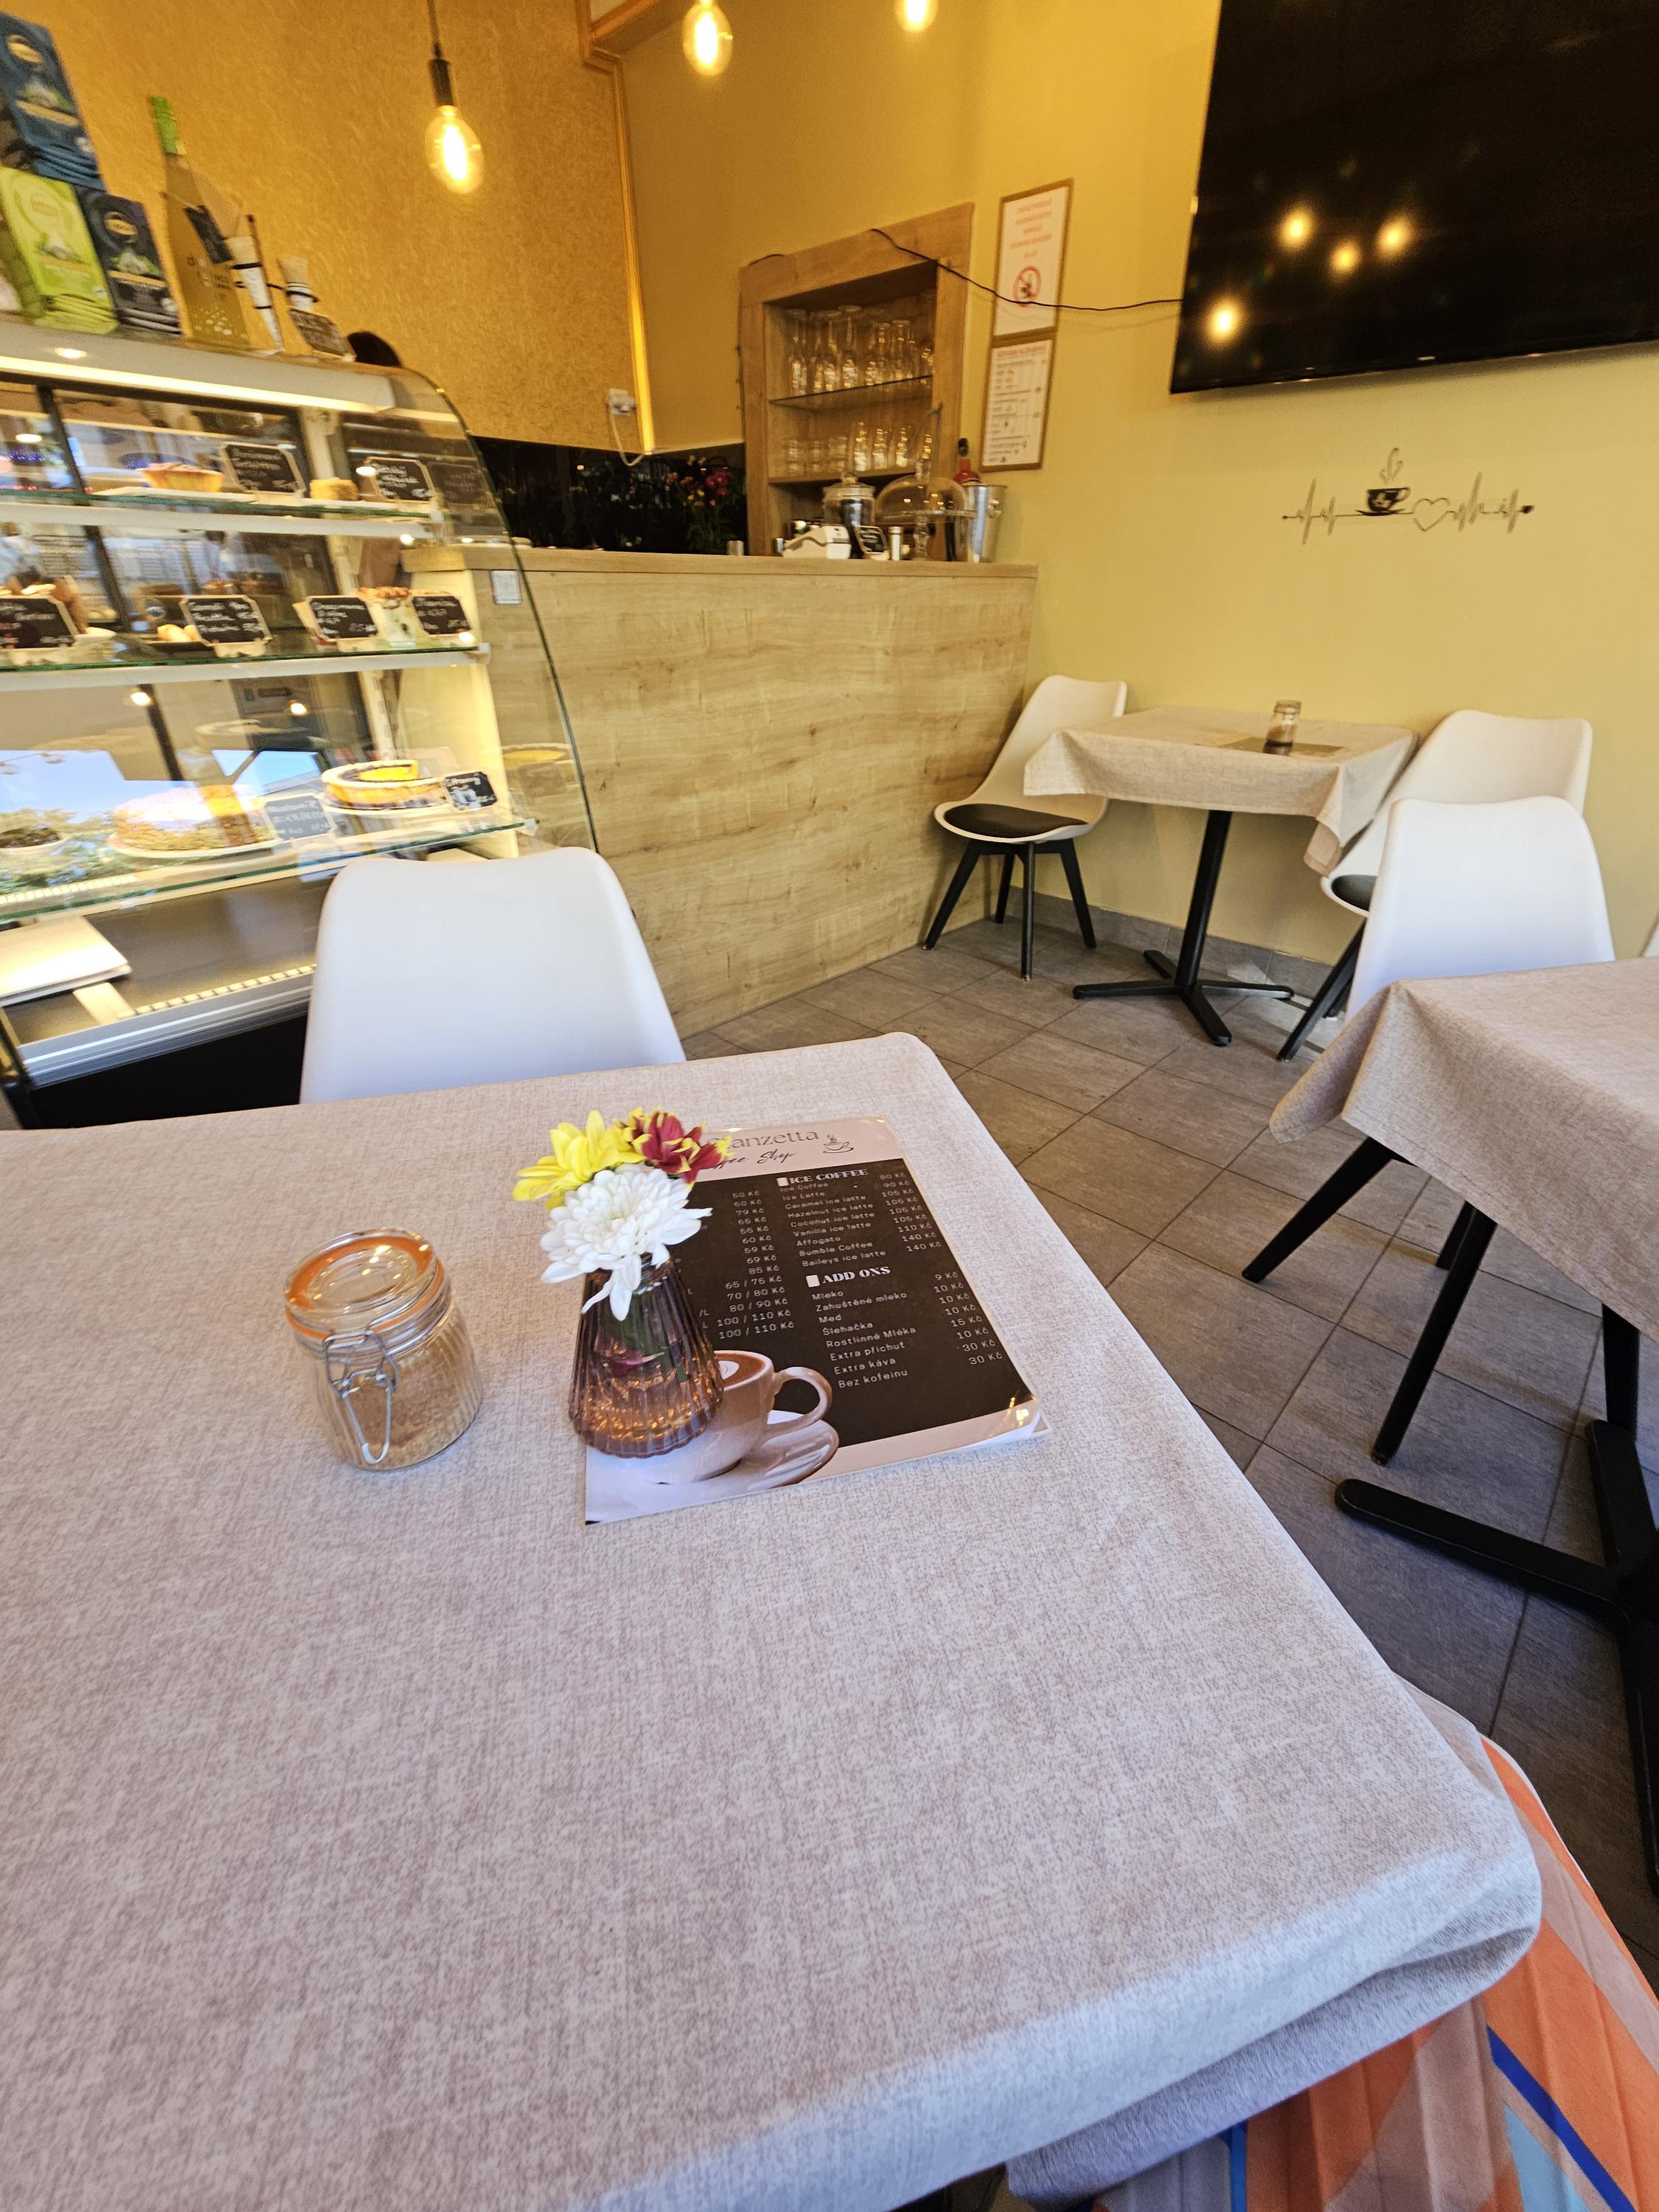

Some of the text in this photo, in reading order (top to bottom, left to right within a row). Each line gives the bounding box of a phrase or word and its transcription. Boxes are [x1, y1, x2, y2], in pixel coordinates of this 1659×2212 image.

[757, 1149, 796, 1164] Shop
[790, 1169, 868, 1183] ICE COFFEE
[785, 1200, 824, 1209] Caramel
[787, 1209, 830, 1219] Hazelnut
[790, 1218, 830, 1227] Coconut
[793, 1228, 827, 1237] Vanilla
[797, 1237, 841, 1246] Affogato
[898, 1225, 917, 1233] 110
[799, 1247, 835, 1256] Bumble
[838, 1242, 872, 1251] Coffee
[902, 1234, 922, 1242] 140
[801, 1257, 838, 1267] Baileys
[906, 1244, 927, 1252] 140
[823, 1266, 891, 1284] ADD ONS
[727, 1293, 742, 1301] 70
[754, 1289, 768, 1297] 80
[933, 1284, 947, 1293] 10
[730, 1304, 744, 1312] 80
[756, 1300, 771, 1308] 90
[818, 1314, 842, 1323] Med
[939, 1295, 953, 1304] 10
[945, 1307, 959, 1315] 10
[717, 1317, 739, 1326] 100
[752, 1312, 773, 1321] 110
[719, 1329, 742, 1339] 100
[755, 1324, 776, 1334] 110
[883, 1327, 917, 1338] Mléka
[951, 1318, 965, 1326] 15
[830, 1351, 861, 1361] Extra
[956, 1330, 972, 1339] 10
[834, 1364, 866, 1374] Extra
[869, 1358, 896, 1368] káva
[962, 1343, 978, 1351] 30
[838, 1379, 860, 1388] Bez
[863, 1370, 908, 1383] kofeinu
[969, 1355, 985, 1365] 30
